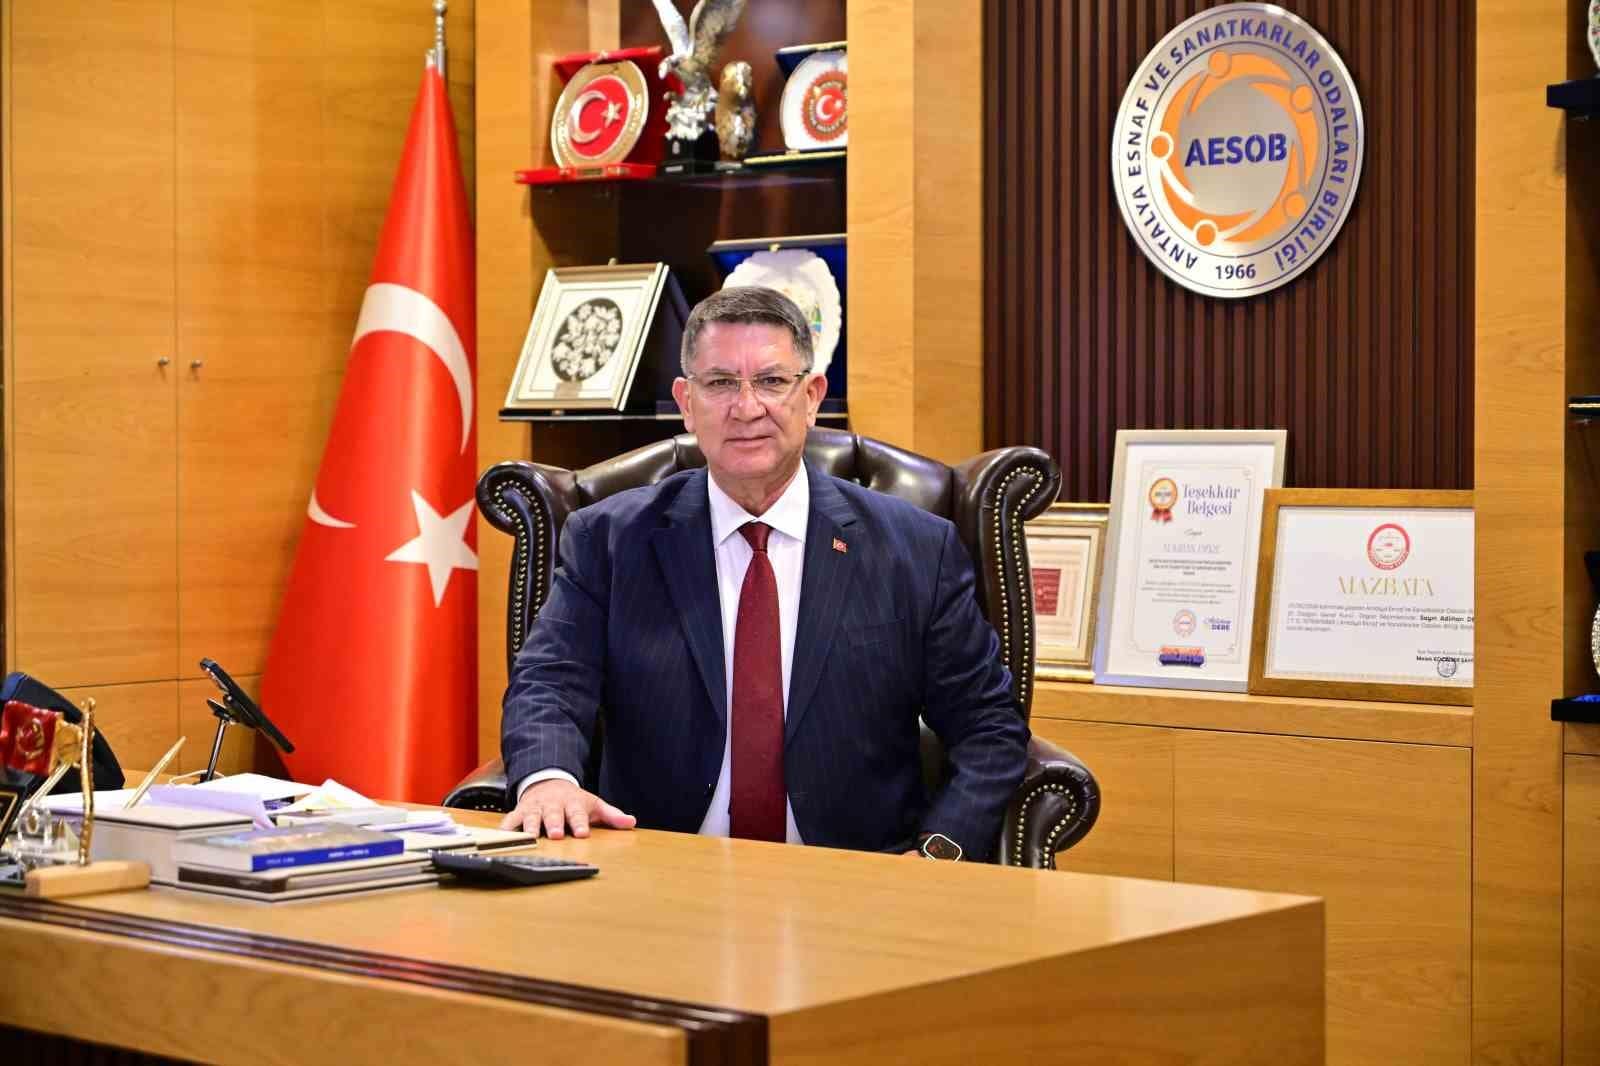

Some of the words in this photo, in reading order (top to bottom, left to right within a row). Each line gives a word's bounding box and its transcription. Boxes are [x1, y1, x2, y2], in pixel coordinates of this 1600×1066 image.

[1171, 19, 1321, 69] SANATKARLAR
[1145, 62, 1171, 92] VE
[1128, 97, 1150, 177] ESNAF
[1185, 133, 1288, 168] AESOB
[1318, 70, 1350, 184] ODALARI
[1131, 185, 1199, 270] ANTALYA
[1274, 191, 1340, 272] BİRLİĞİ
[1215, 264, 1256, 280] 1966
[1187, 500, 1232, 517] Belgesi
